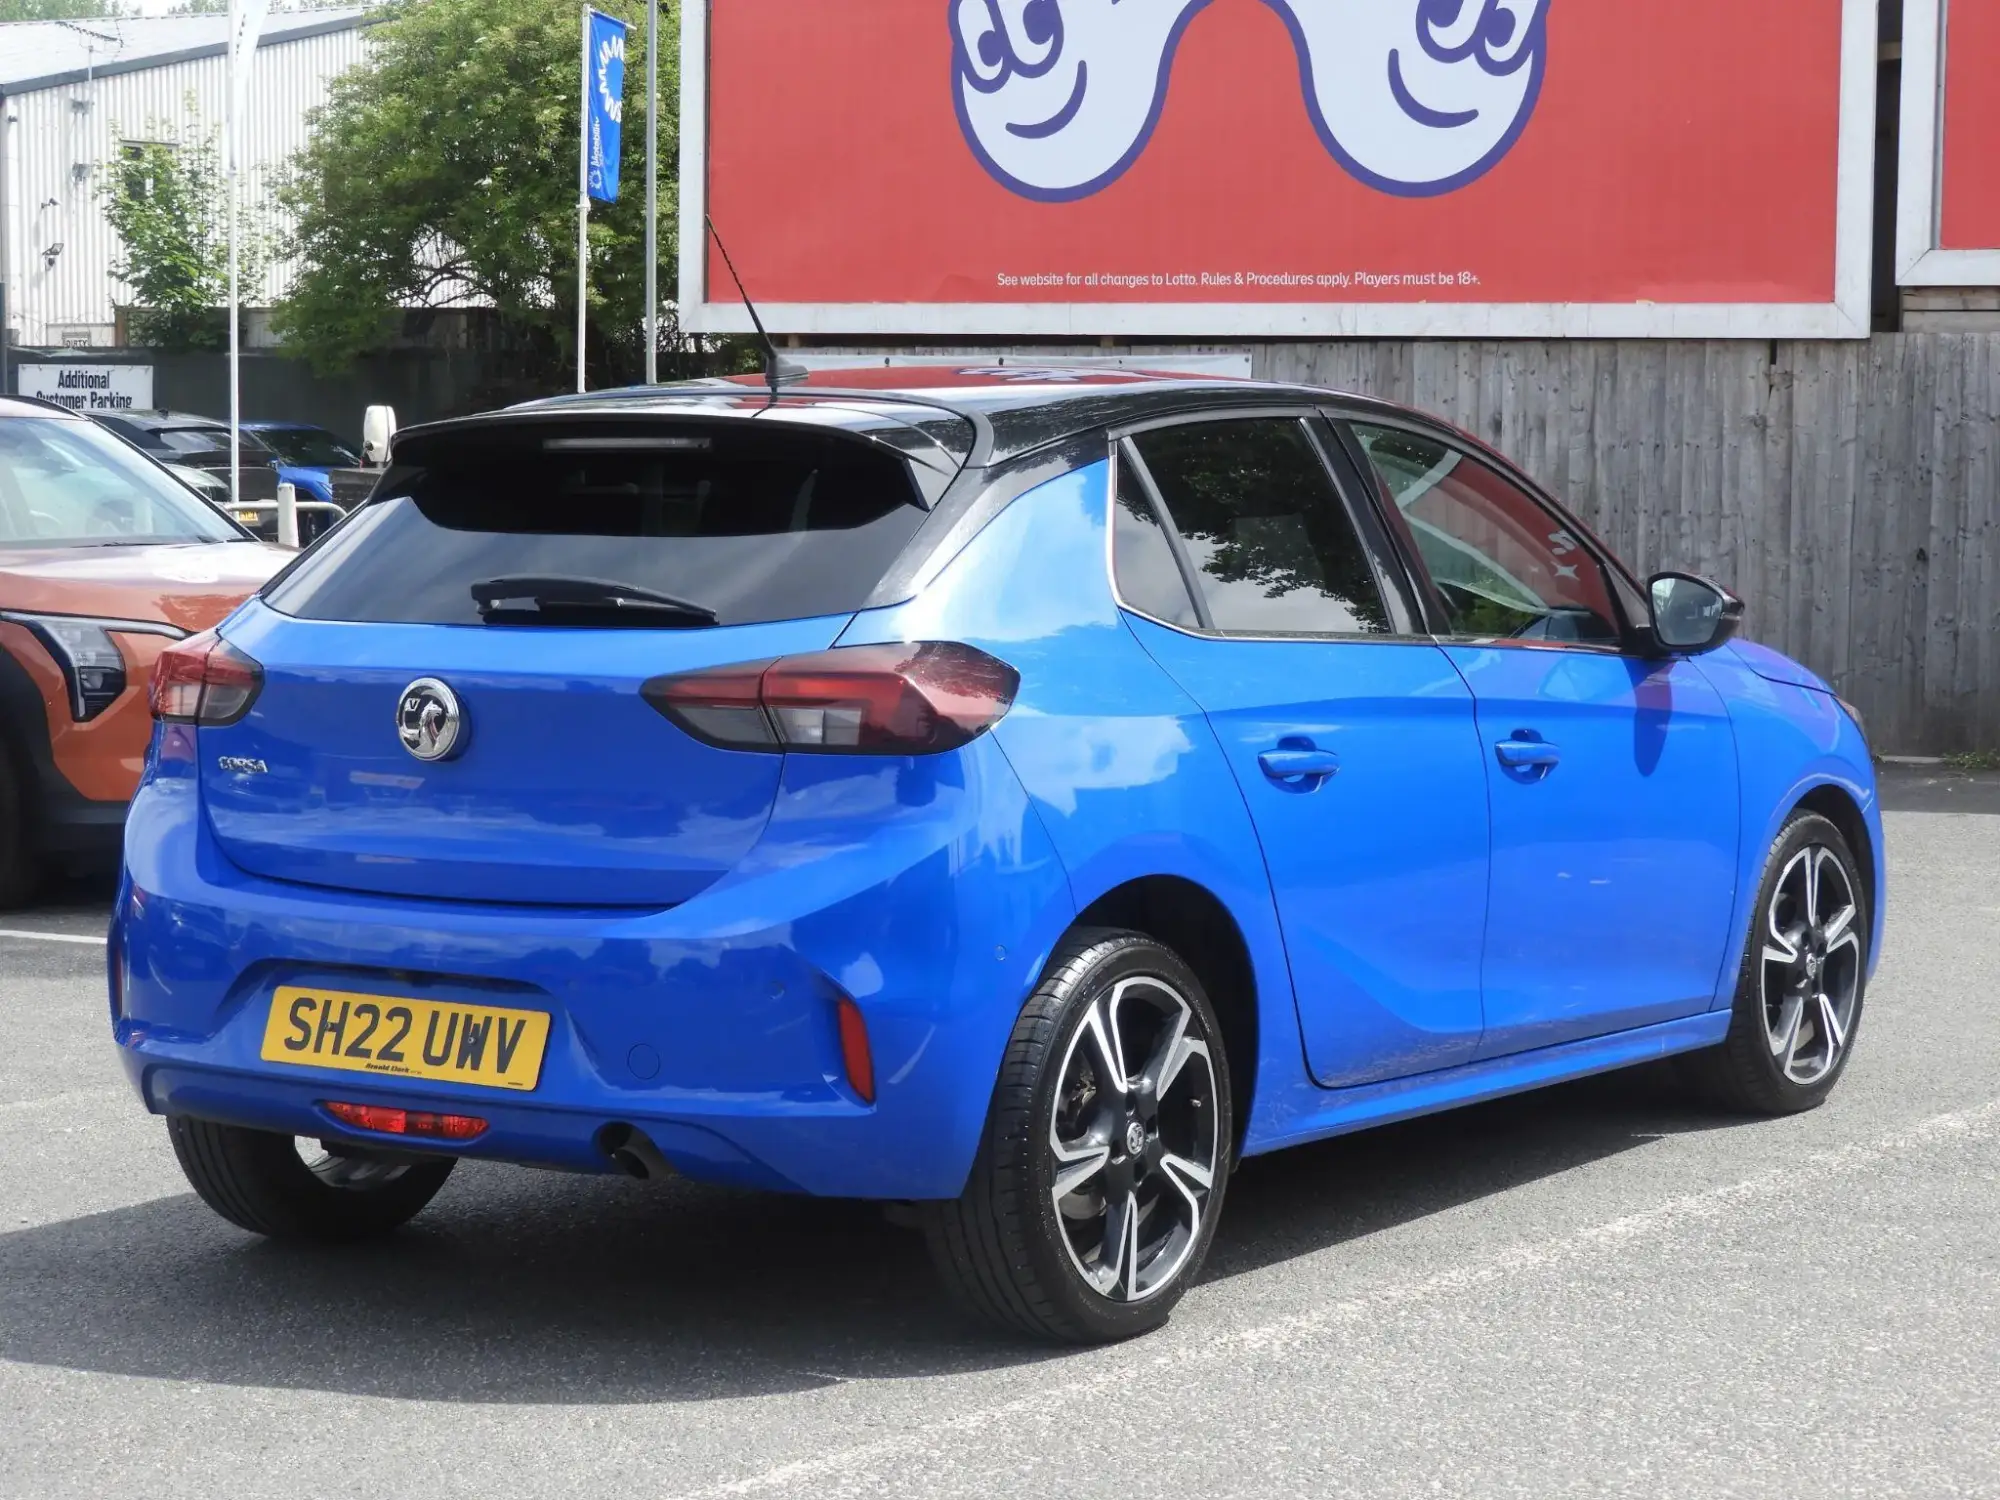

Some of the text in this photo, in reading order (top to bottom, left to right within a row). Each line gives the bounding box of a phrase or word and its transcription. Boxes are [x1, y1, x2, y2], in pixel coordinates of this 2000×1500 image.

[997, 271, 1481, 288] See website for all changes to Lotto. Rules & Procedures apply. Players must be 18+.
[58, 370, 110, 389] Additional
[90, 391, 132, 409] Parking
[284, 997, 527, 1074] SH22 UWV
